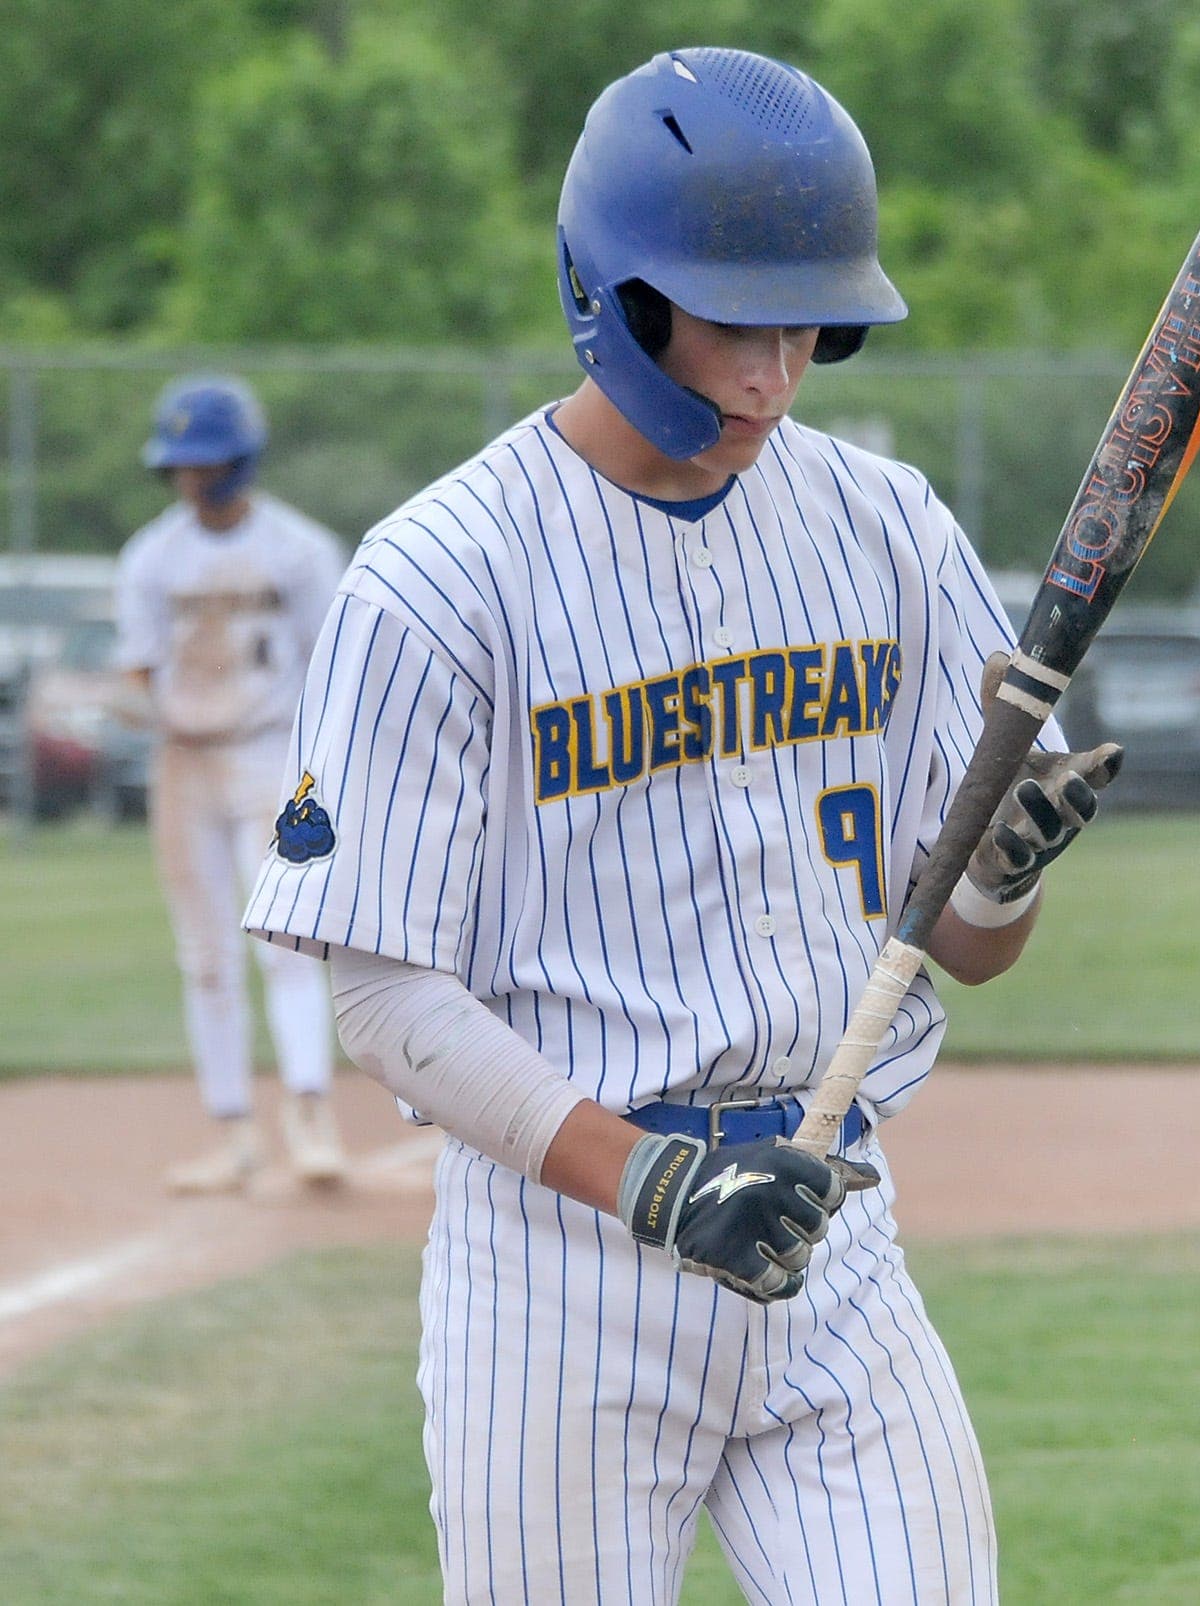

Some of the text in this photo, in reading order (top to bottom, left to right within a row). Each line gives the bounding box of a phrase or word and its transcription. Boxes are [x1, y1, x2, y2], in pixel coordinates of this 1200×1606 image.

[530, 639, 902, 806] BLUESTREAKS
[814, 783, 888, 921] 9
[648, 1149, 689, 1228] BRUCE BOLT
